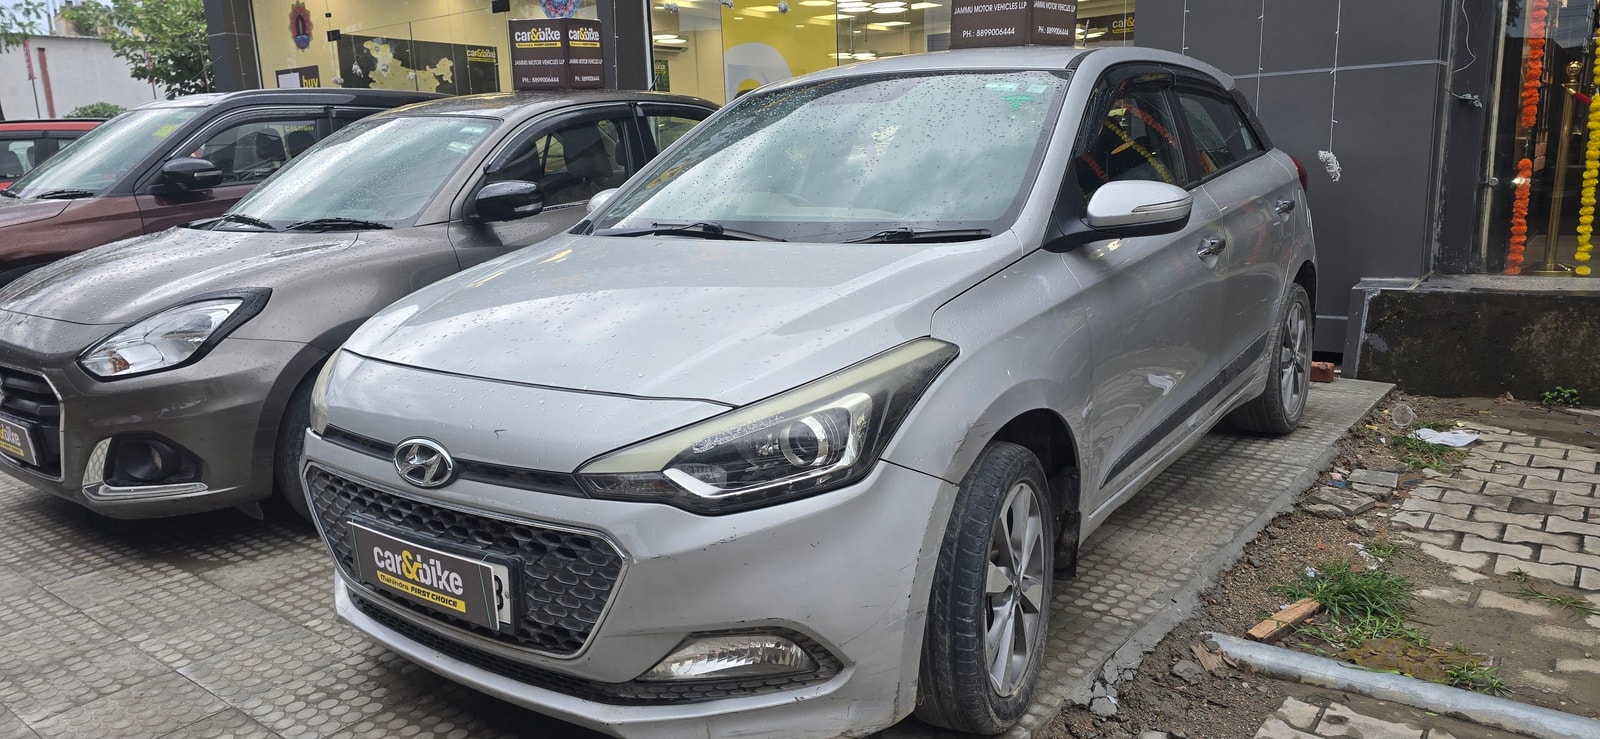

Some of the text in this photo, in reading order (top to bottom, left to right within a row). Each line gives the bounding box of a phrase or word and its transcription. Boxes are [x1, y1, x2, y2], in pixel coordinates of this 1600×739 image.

[953, 1, 1027, 15] JAMMU MOTOR VEHICLES LLP
[514, 27, 561, 42] car&bike
[568, 27, 600, 42] car&bike
[976, 27, 1015, 37] 8899006444
[373, 546, 464, 596] car&bike
[410, 586, 431, 598] FIRST
[431, 594, 458, 608] CHOICE
